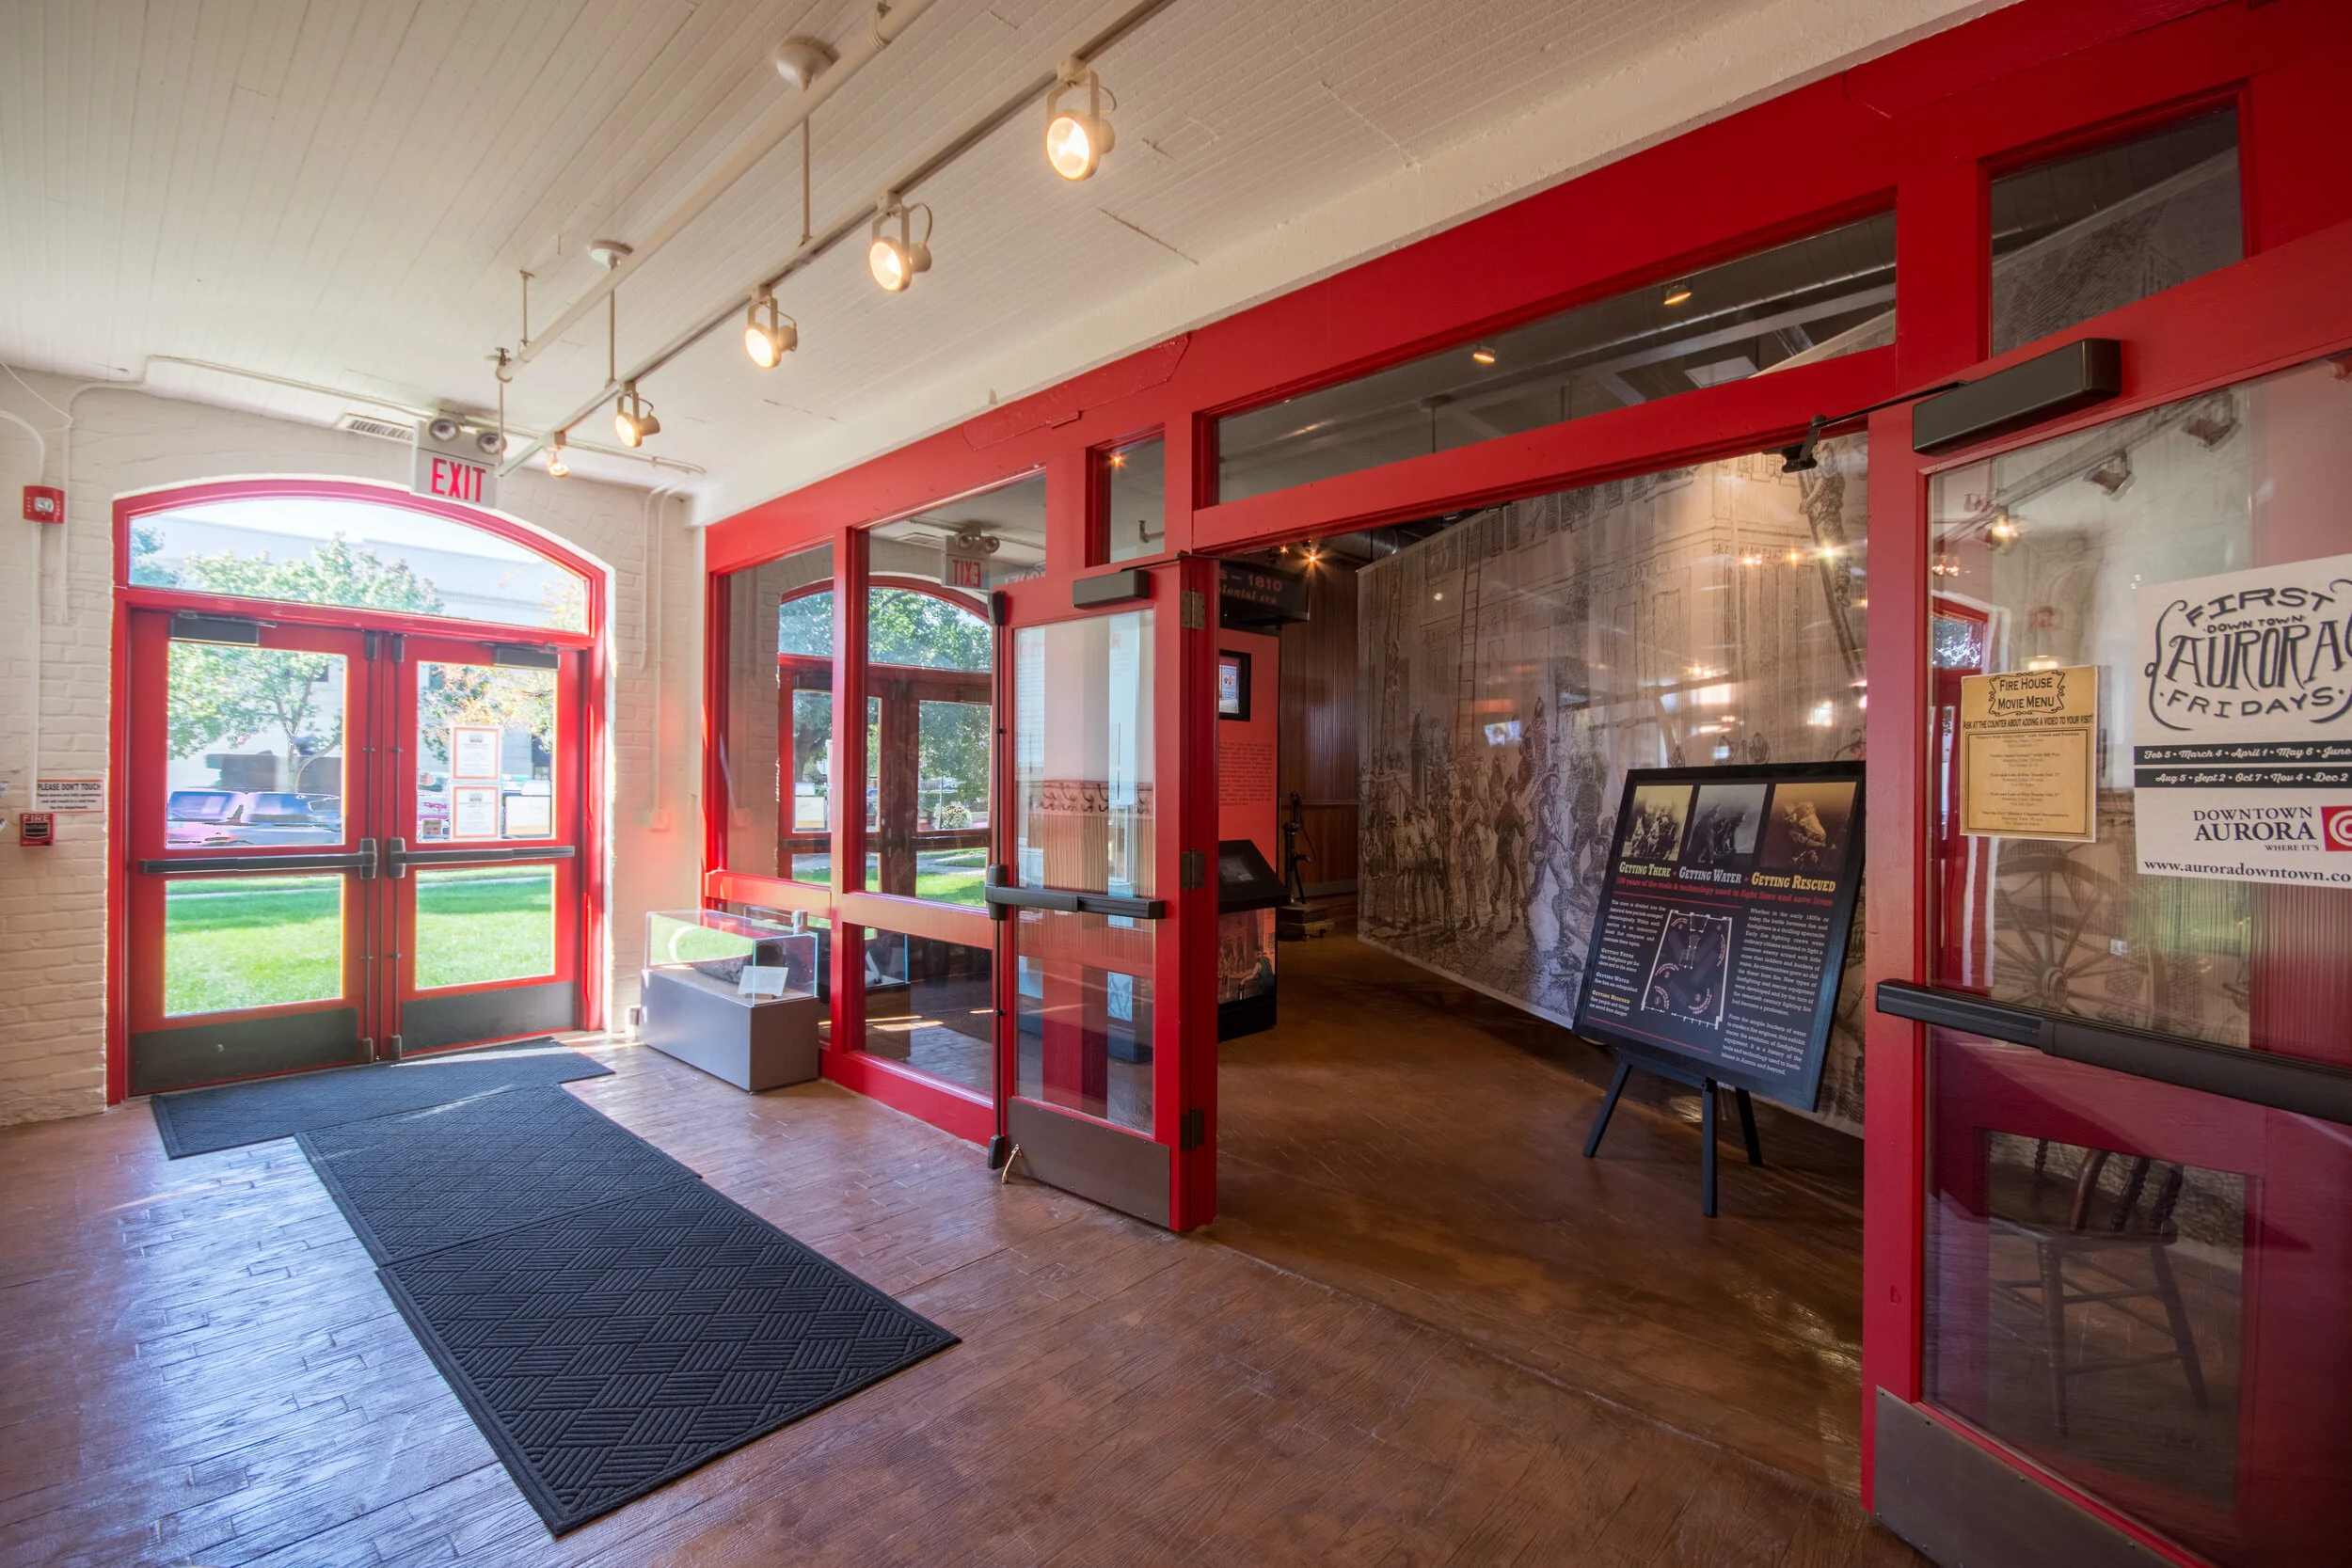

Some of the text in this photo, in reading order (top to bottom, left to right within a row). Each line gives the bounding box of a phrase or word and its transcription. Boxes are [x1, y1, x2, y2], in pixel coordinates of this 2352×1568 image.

[431, 457, 486, 503] EXIT
[1248, 574, 1282, 592] 1810
[1220, 584, 1256, 600] lonial
[2185, 588, 2335, 627] FIRST
[2164, 620, 2346, 691] AURORA
[1999, 677, 2053, 691] FIRE HOUSE
[1998, 696, 2055, 709] MOVIE MENU
[2167, 687, 2335, 718] FRIDAYS
[1987, 719, 2007, 728] COUNTER
[2008, 718, 2022, 727] ABOUT
[2022, 718, 2039, 726] ADDING
[2044, 716, 2058, 725] VIDEO
[2059, 716, 2065, 724] TO
[2066, 716, 2079, 724] YOUR
[2144, 750, 2164, 760] Feb
[2179, 750, 2214, 758] March
[2215, 750, 2222, 758] 4
[2231, 749, 2261, 758] April
[2276, 747, 2304, 759] May
[2306, 747, 2313, 756] 6
[2321, 746, 2352, 757] June
[2155, 772, 2348, 784] Aug 5 Sept 2 Oct 7 Nov 4 Dec 2
[2193, 806, 2312, 821] DOWNTOWN
[2194, 821, 2317, 841] AURORA
[1618, 861, 1836, 893] GETTING THERE GETTING WATER GETTING RESCUED
